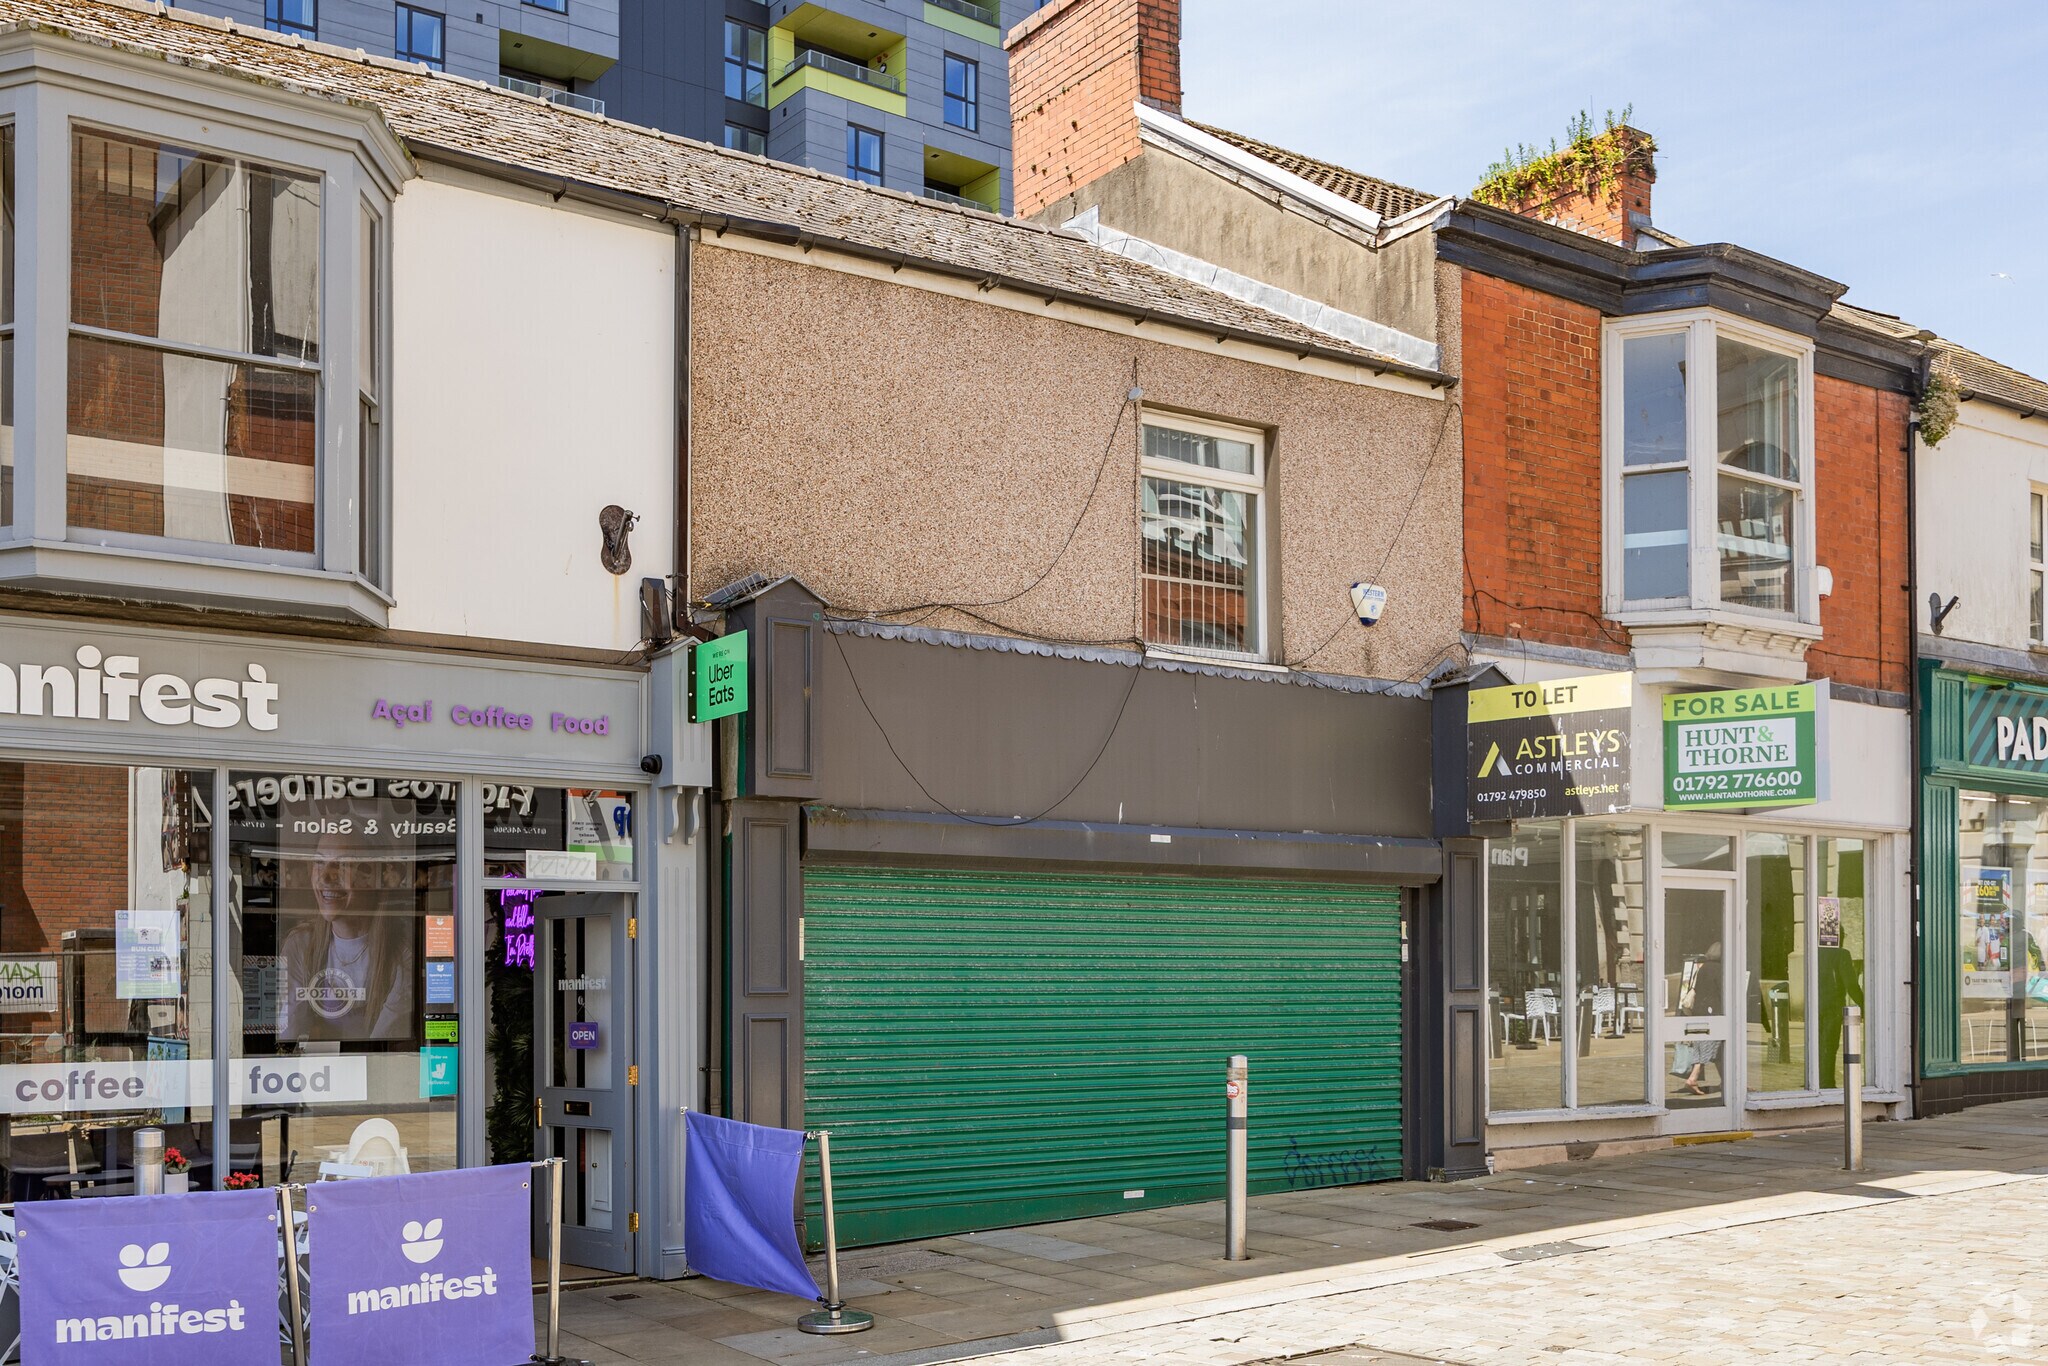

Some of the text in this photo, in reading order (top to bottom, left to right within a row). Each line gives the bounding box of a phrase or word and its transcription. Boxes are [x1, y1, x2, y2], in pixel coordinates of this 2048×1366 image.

[709, 663, 734, 684] Uber
[709, 685, 734, 706] Eats
[1511, 685, 1578, 708] TO LET
[1673, 691, 1800, 717] FOR SALE
[451, 704, 534, 731] Coffee
[552, 712, 609, 737] Food
[1515, 729, 1620, 760] ASTLEYS
[1686, 744, 1789, 767] THORNE
[1515, 757, 1620, 775] COMMERCIAL
[1477, 783, 1619, 802] 01792 479850 astleys.net
[1673, 771, 1802, 791] 01792 776600
[1679, 788, 1797, 801] WWW.HUNTANDTHORNE.COM
[558, 974, 607, 991] manifest
[571, 1030, 595, 1041] OPEN
[15, 1070, 144, 1102] coffee
[249, 1065, 331, 1094] food
[347, 1266, 498, 1315] manifest
[56, 1299, 246, 1344] manifest
